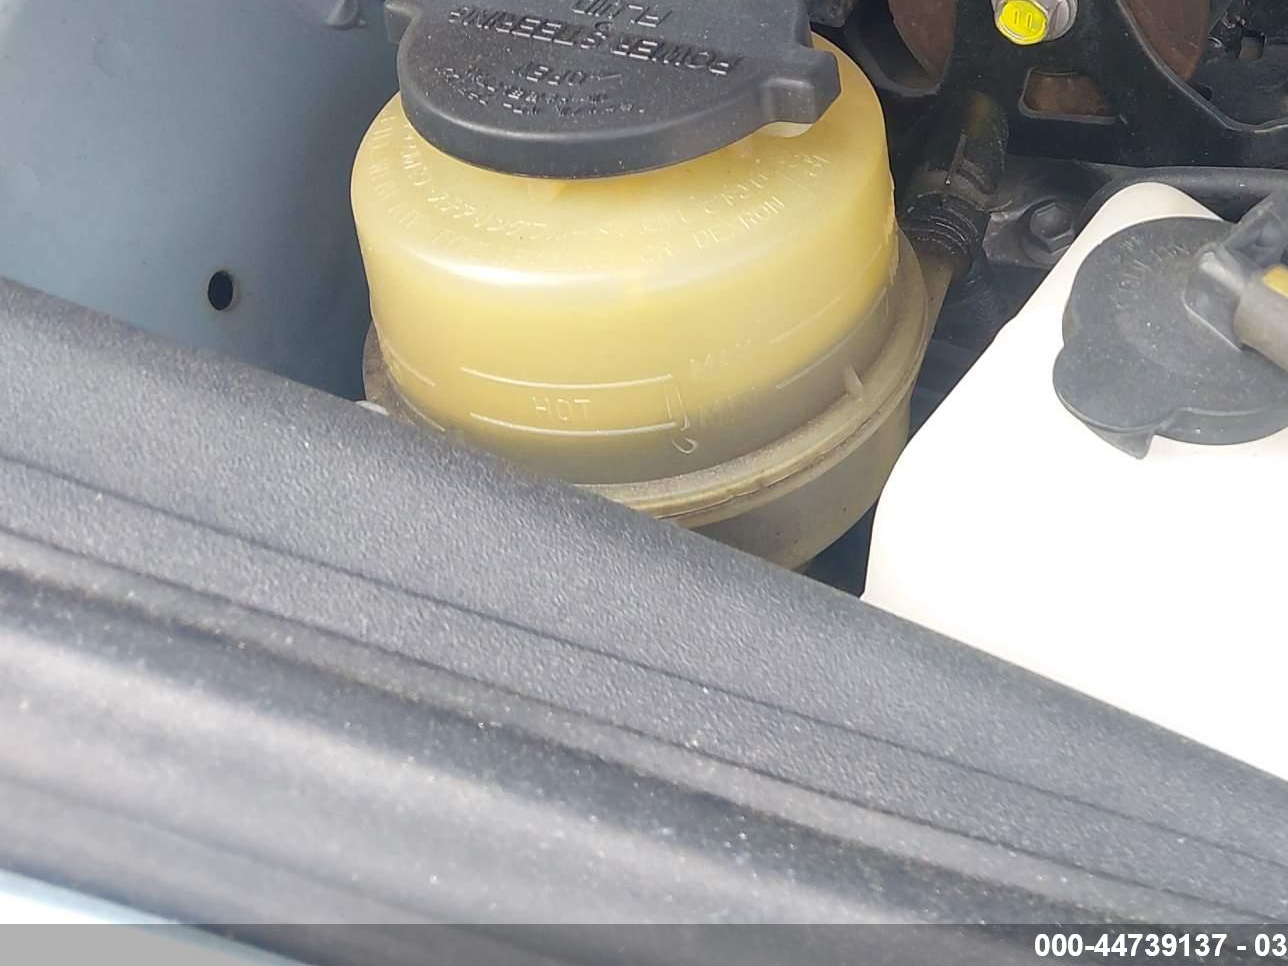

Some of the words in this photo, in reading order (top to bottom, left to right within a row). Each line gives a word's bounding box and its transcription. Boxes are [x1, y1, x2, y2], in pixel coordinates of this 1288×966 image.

[448, 5, 604, 50] STEERING
[610, 36, 745, 76] POWER
[532, 395, 591, 422] HOT
